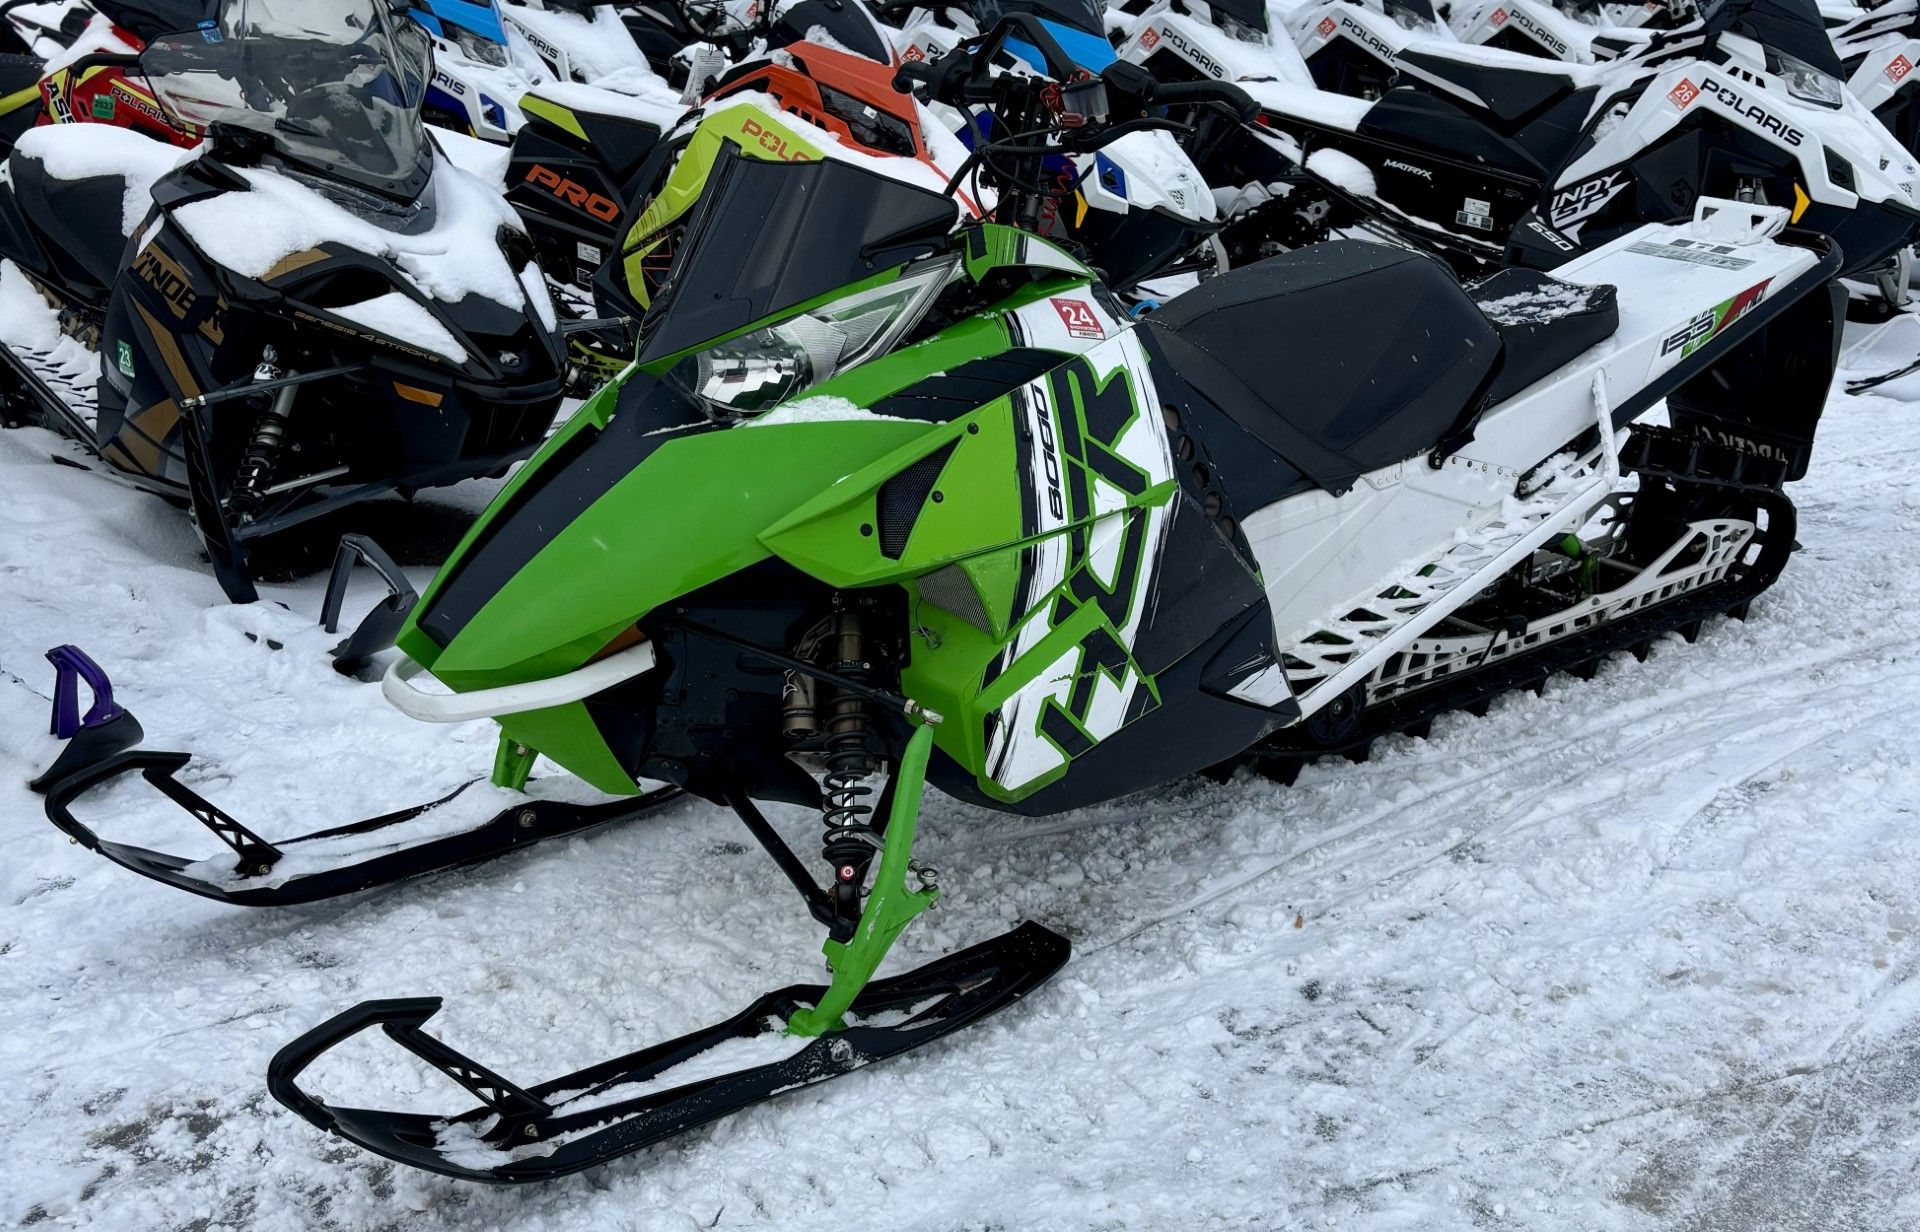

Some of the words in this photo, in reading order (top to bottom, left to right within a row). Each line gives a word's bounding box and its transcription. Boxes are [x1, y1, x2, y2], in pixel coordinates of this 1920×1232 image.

[1143, 31, 1156, 44] 26
[1509, 9, 1567, 55] POLARIS
[1161, 27, 1224, 79] POLARIS
[1890, 60, 1907, 77] 26
[1674, 84, 1691, 102] 26
[1700, 77, 1805, 147] POLARIS
[1383, 158, 1433, 181] MATRYX
[525, 164, 620, 222] PRO
[1551, 170, 1622, 211] INDY
[1526, 221, 1574, 251] 650
[1061, 305, 1094, 326] 24
[119, 347, 131, 368] 23
